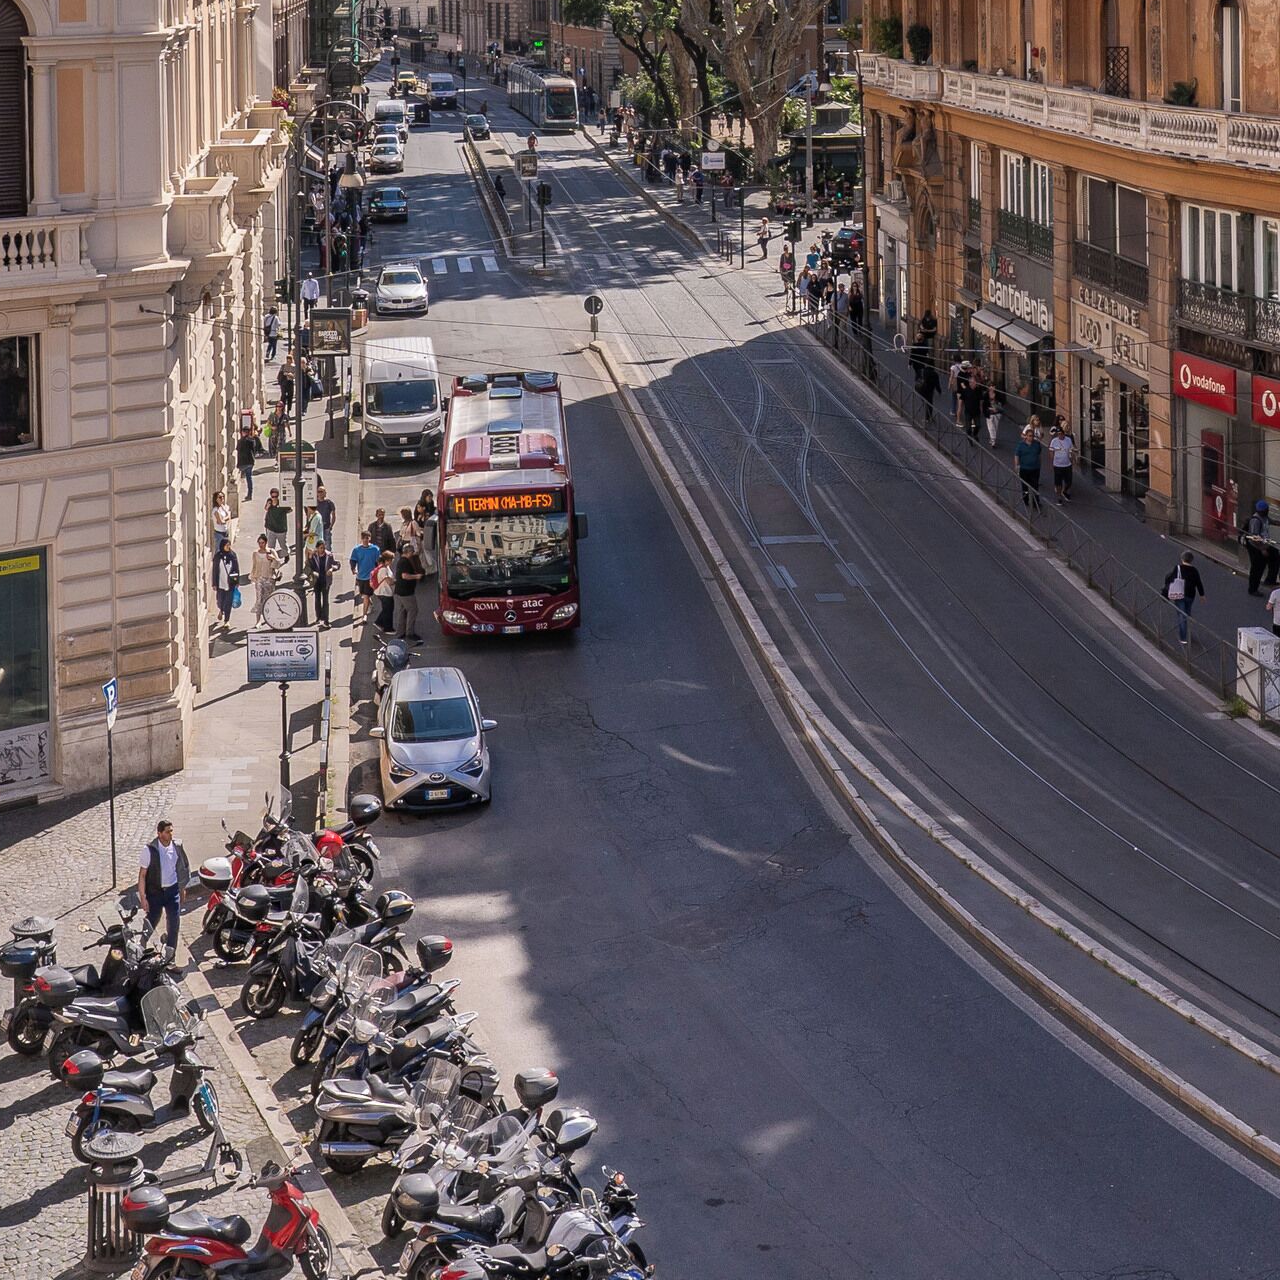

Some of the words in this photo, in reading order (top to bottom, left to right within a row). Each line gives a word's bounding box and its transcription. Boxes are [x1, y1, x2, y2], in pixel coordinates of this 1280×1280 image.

[1079, 286, 1140, 327] CALZATURE
[1079, 314, 1100, 345] UGO
[1115, 334, 1149, 372] CELLI
[1192, 374, 1226, 394] vodafone
[455, 497, 465, 513] H
[468, 497, 499, 511] TERMINI
[501, 494, 552, 509] (MA-MB-FS)
[474, 602, 500, 611] ROMA
[522, 599, 544, 608] atac
[535, 622, 548, 630] 812
[106, 684, 115, 710] P
